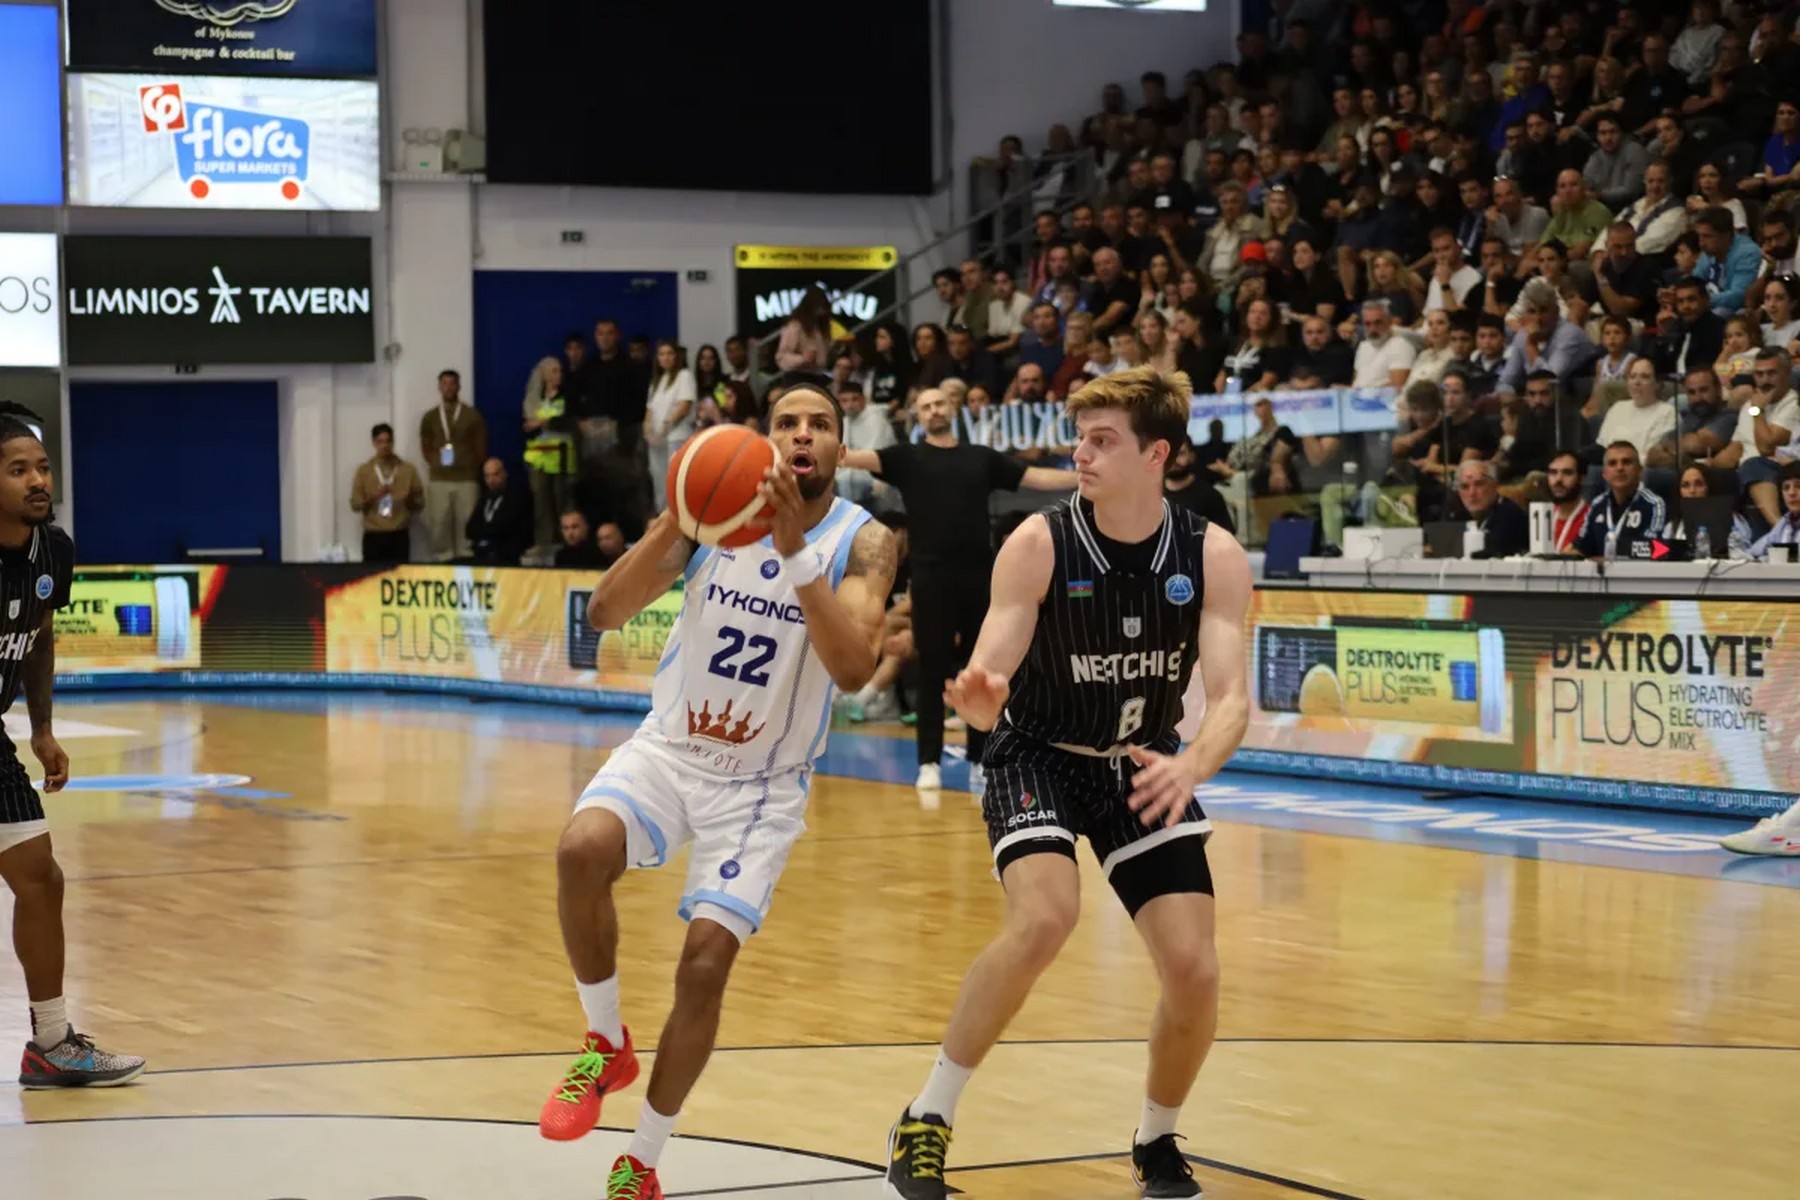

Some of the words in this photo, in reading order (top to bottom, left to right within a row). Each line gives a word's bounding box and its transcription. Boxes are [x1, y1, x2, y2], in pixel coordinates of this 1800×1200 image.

[152, 44, 215, 60] champagne
[218, 46, 230, 59] &
[231, 47, 275, 60] cocktail
[182, 107, 303, 159] flora
[194, 161, 235, 174] SUPER
[238, 161, 297, 175] MARKETS
[69, 287, 199, 315] LIMNIOS
[249, 287, 370, 314] TAVERN
[380, 578, 497, 610] DEXTROLYTE
[707, 583, 806, 625] YKONO
[380, 612, 452, 662] PLUS
[707, 626, 777, 688] 22
[1346, 649, 1443, 671] DEXTROLYTE
[1346, 670, 1398, 704] PLUS
[1669, 684, 1753, 707] HYDRATING
[1552, 677, 1664, 748] PLUS
[1669, 707, 1768, 732] ELECTROLYTE
[1669, 731, 1697, 751] MIX
[1007, 809, 1058, 828] SOCAR
